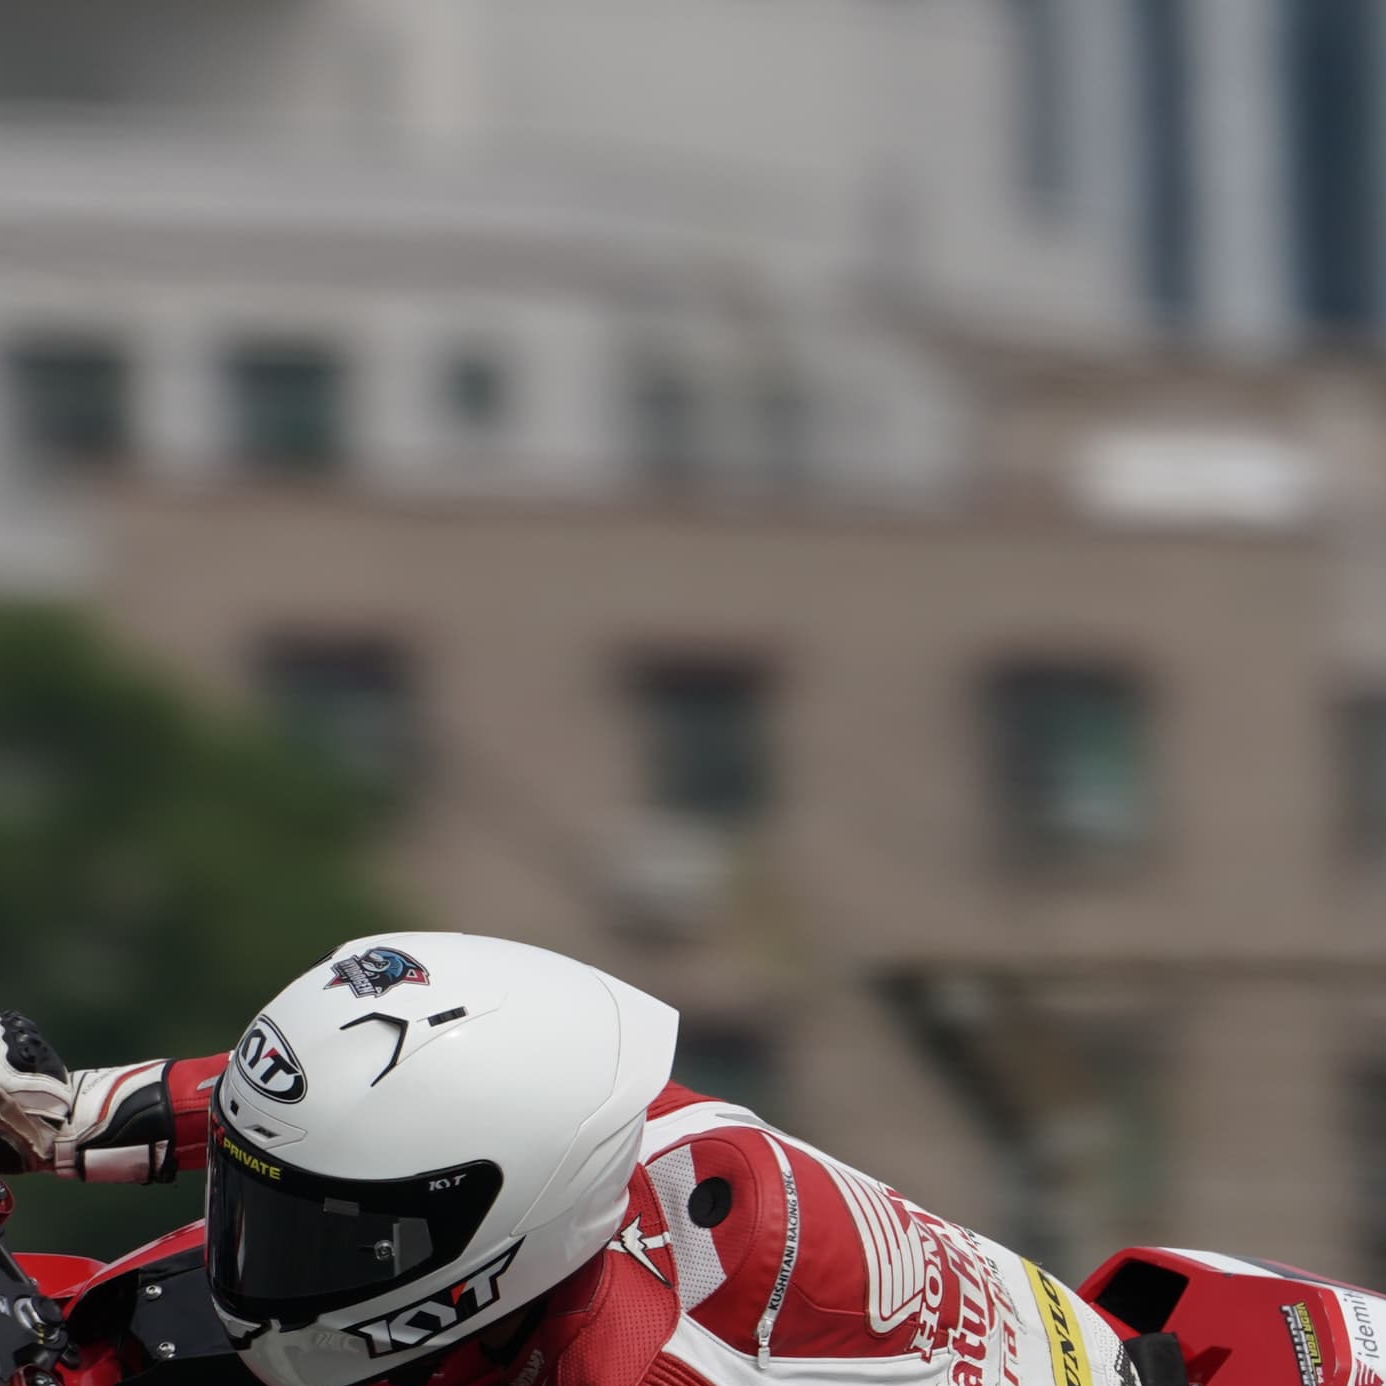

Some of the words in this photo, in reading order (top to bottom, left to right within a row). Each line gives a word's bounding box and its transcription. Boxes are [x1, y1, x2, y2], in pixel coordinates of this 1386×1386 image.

[782, 1170, 797, 1195] SPEC
[787, 1199, 798, 1242] RACING
[351, 1246, 518, 1356] KYT
[768, 1245, 795, 1310] KUSHITANI
